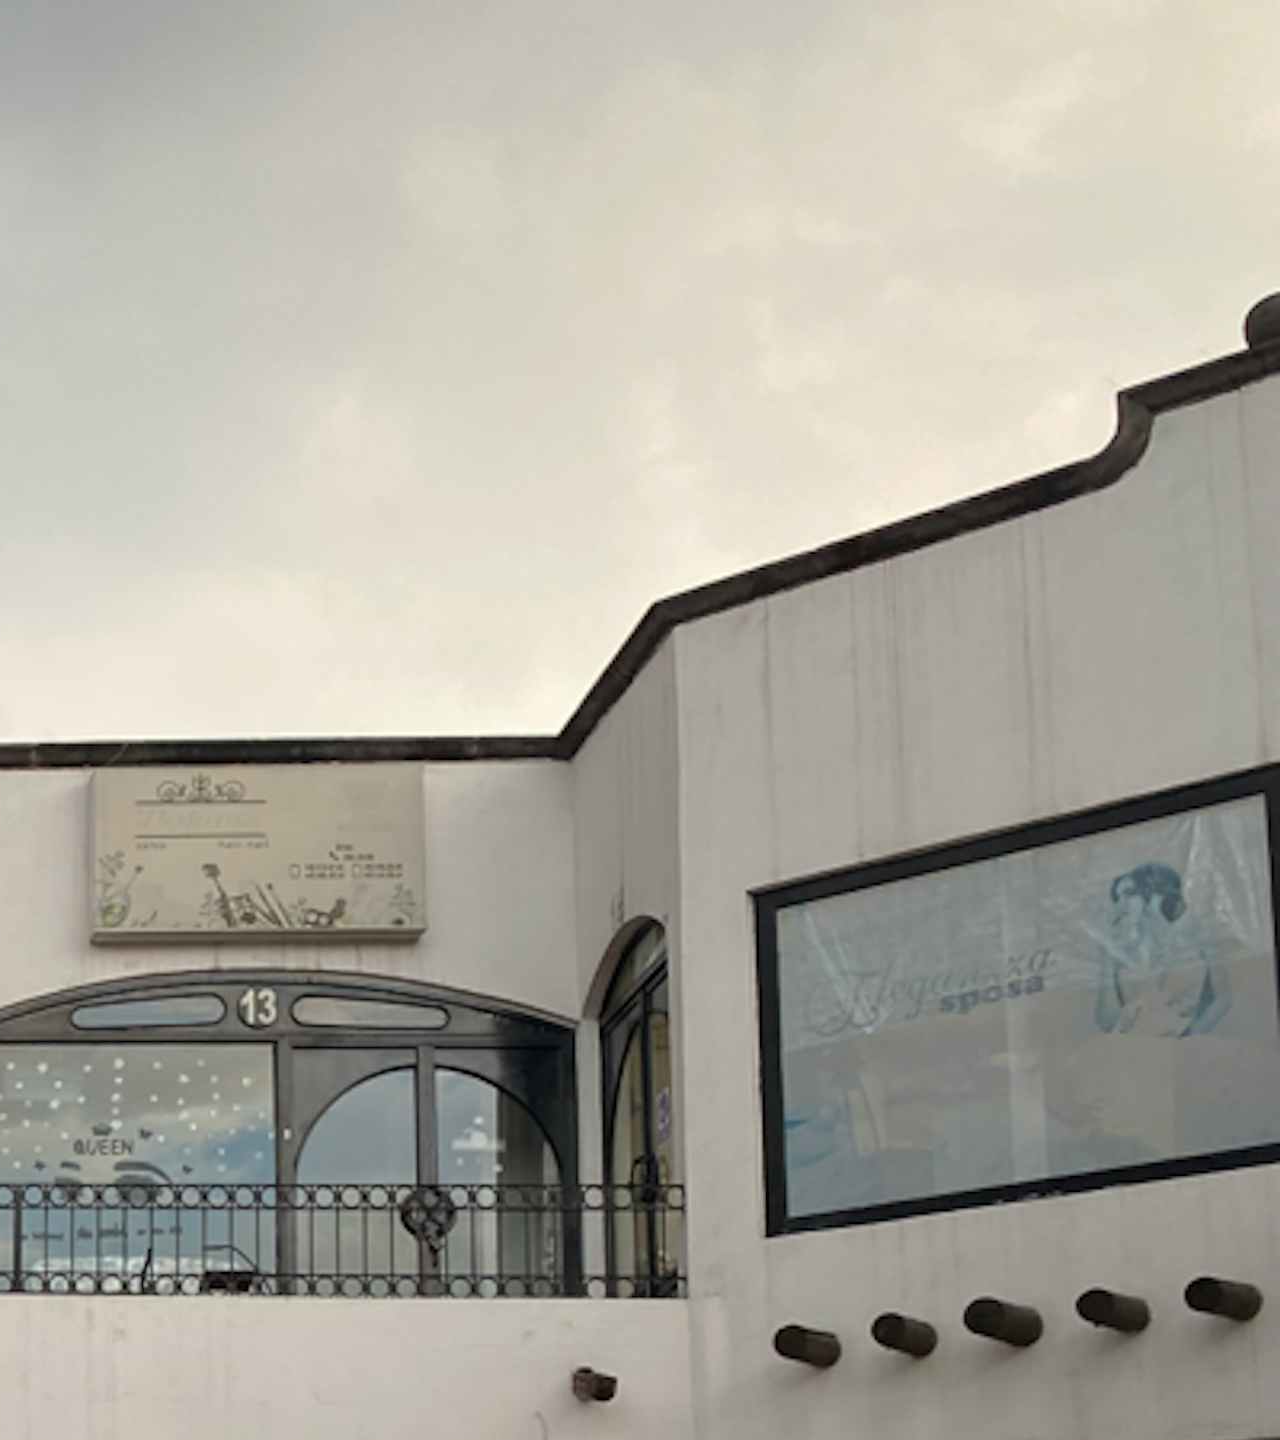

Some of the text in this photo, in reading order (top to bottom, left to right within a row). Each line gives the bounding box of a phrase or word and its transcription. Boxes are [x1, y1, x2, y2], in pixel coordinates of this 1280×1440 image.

[240, 988, 277, 1025] 13
[940, 975, 1044, 1015] sposa
[72, 1138, 135, 1156] QUEEN
